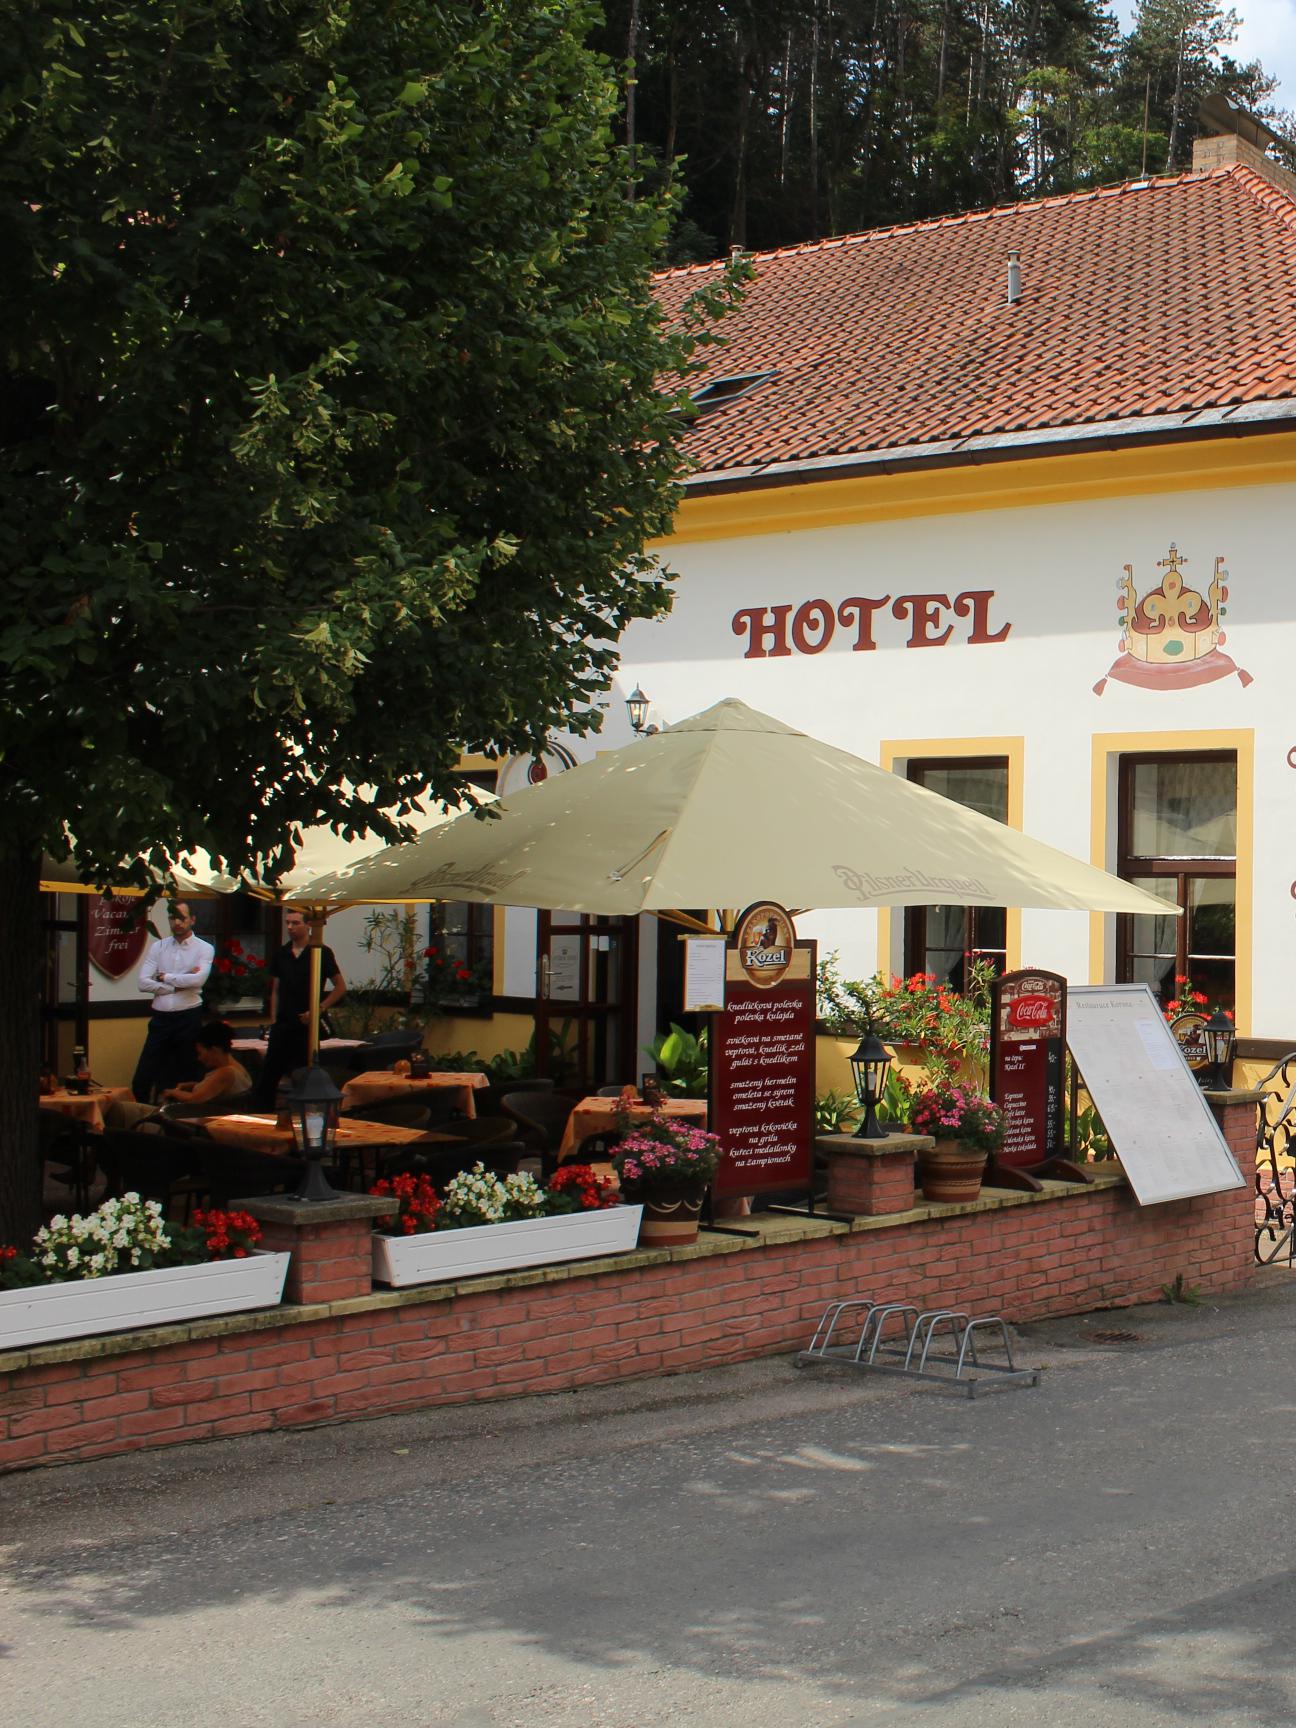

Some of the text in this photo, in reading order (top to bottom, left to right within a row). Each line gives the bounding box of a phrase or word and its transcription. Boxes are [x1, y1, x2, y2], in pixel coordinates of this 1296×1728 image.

[731, 590, 1012, 659] HOTEL
[832, 864, 992, 901] Pilsner Urquell
[94, 926, 141, 936] Zimr
[104, 939, 128, 954] frei
[746, 948, 788, 967] Kozel
[772, 999, 803, 1011] polévka
[734, 1010, 795, 1024] polévka kulajda
[732, 1089, 762, 1099] omeleta
[758, 1133, 778, 1145] grilu
[754, 1142, 797, 1154] medailonky
